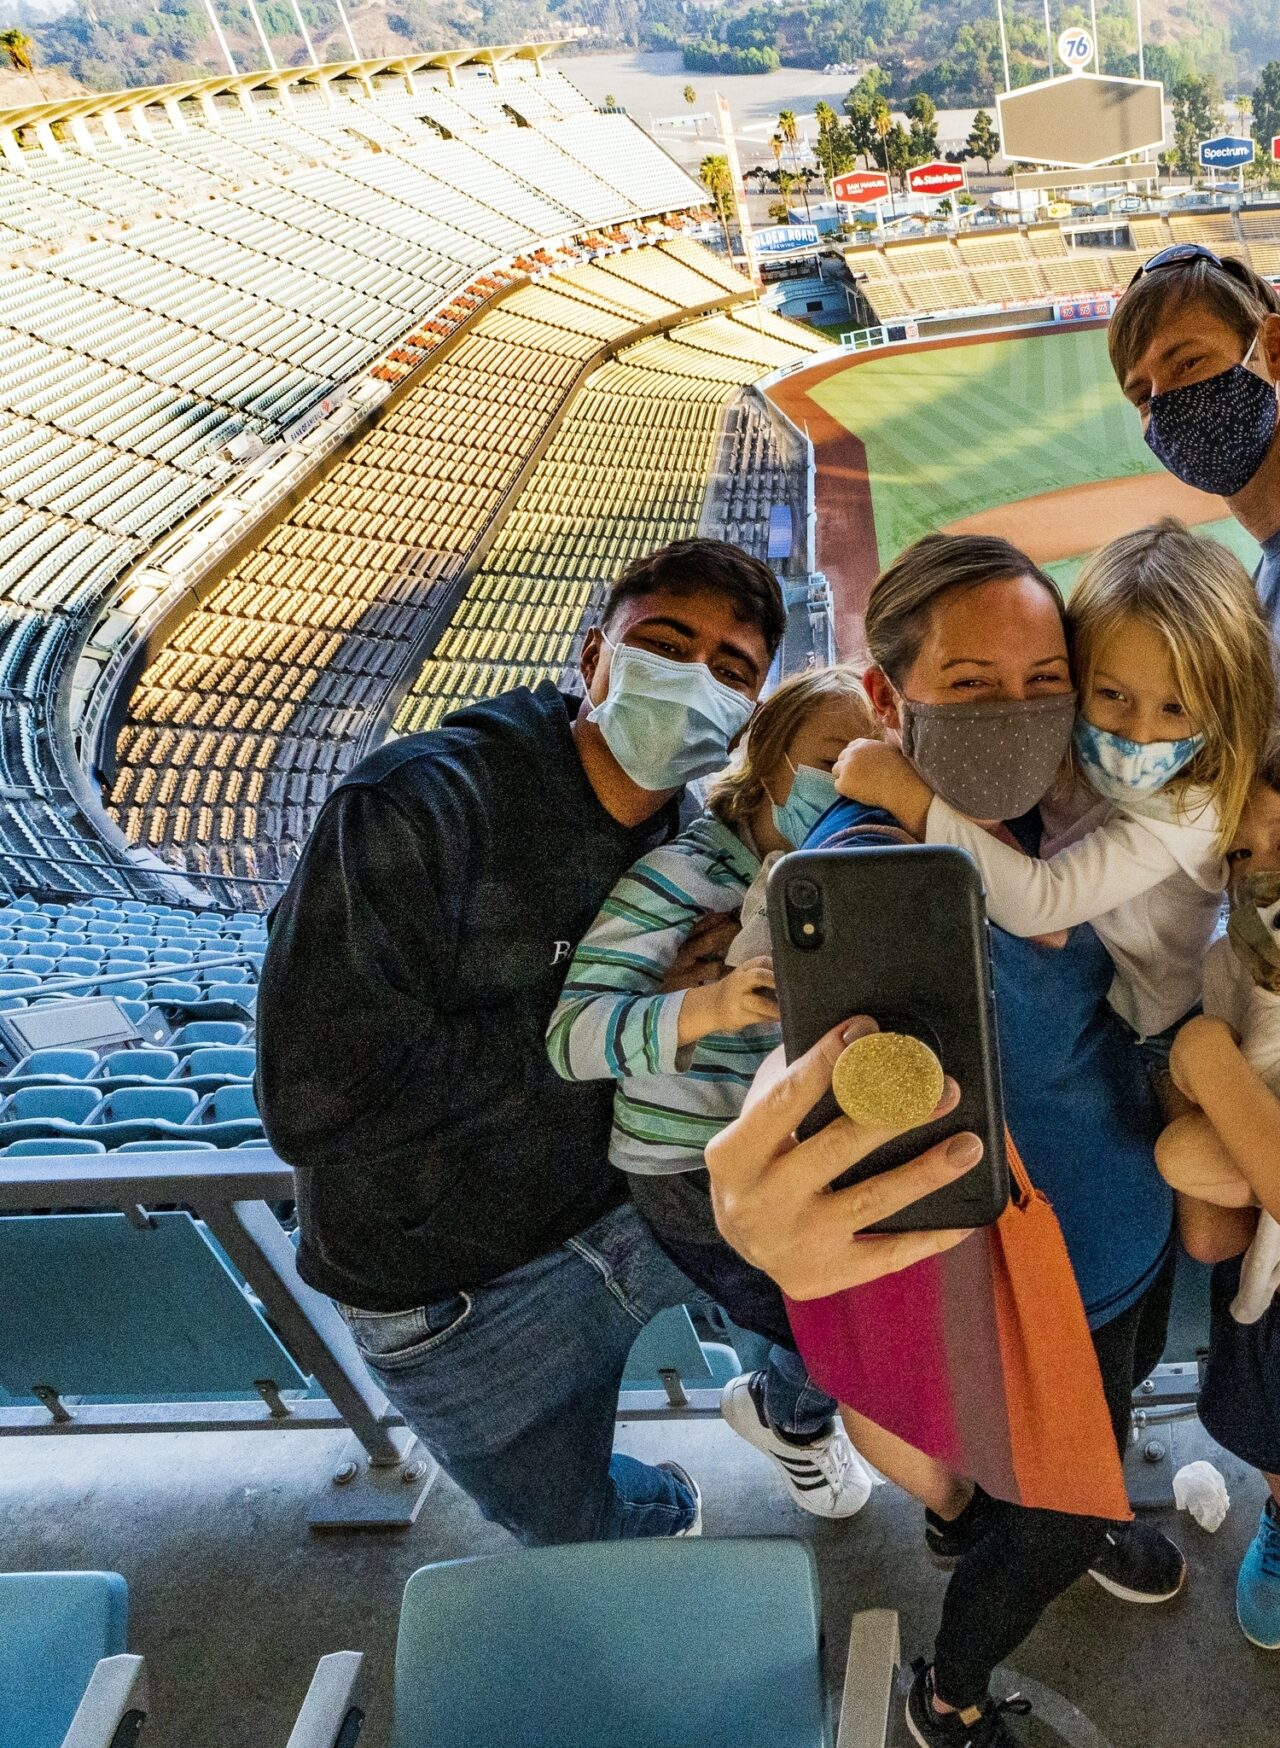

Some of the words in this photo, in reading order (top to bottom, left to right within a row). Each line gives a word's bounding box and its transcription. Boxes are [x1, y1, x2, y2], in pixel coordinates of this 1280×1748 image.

[1066, 36, 1088, 57] 76
[1204, 146, 1249, 159] Spectrum
[754, 230, 785, 248] OLDEN
[788, 228, 815, 242] ROAD
